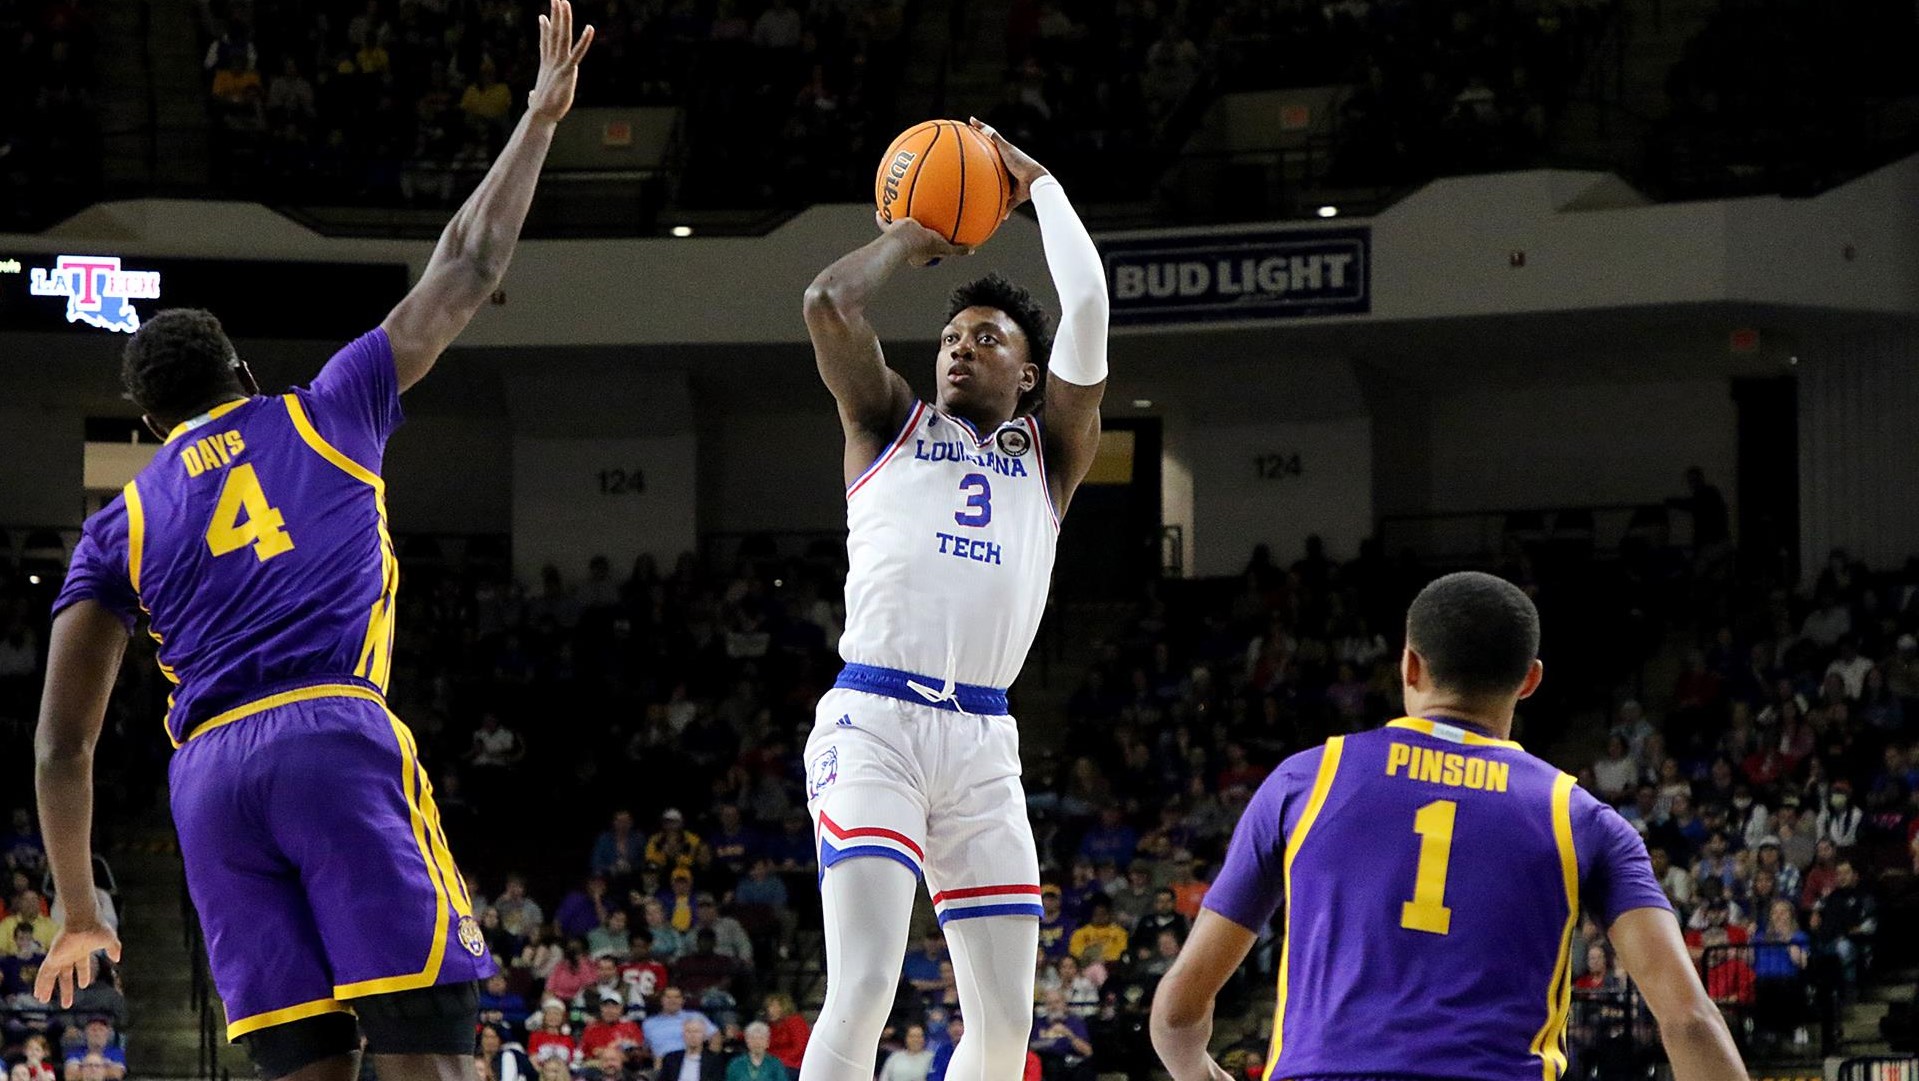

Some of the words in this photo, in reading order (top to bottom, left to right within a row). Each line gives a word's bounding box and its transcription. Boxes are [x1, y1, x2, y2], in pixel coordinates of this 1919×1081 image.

[882, 149, 917, 225] Wilso
[1115, 263, 1210, 300] BUD
[1217, 253, 1353, 295] LIGHT
[180, 429, 246, 478] DAYS
[1254, 453, 1302, 480] 124
[599, 468, 645, 495] 124
[954, 473, 992, 528] 3
[205, 462, 295, 563] 4
[936, 532, 1002, 565] TECH
[1385, 742, 1510, 792] PINSON
[1400, 799, 1457, 935] 1
